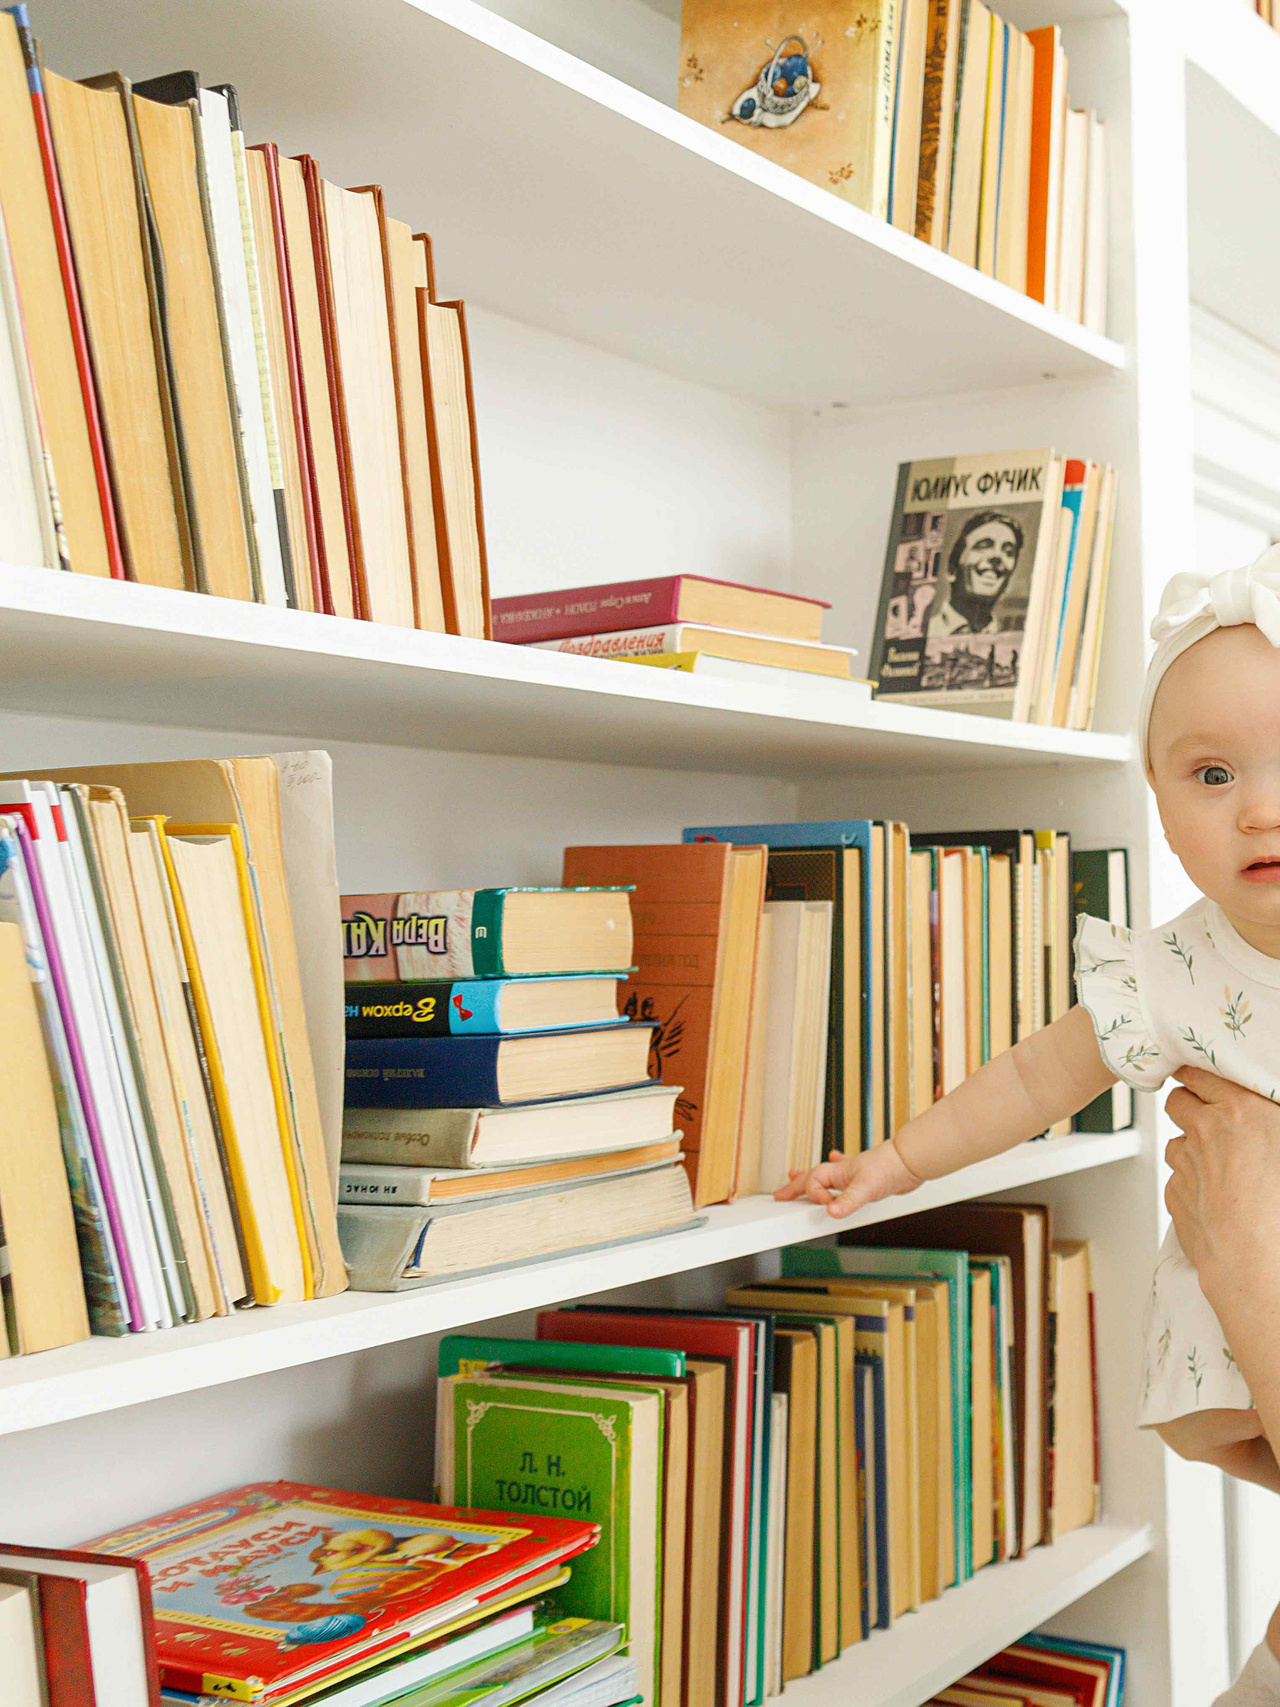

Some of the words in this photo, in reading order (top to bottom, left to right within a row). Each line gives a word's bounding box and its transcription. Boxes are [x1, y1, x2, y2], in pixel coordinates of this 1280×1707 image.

[910, 472, 972, 502] ЮЛИУС
[976, 467, 1043, 494] ФУЧИК
[362, 997, 436, 1022] Верхом
[346, 1184, 379, 1194] ЮНАС
[383, 1185, 398, 1194] ЯН
[547, 1454, 565, 1477] Н.
[495, 1479, 591, 1512] ТОЛСТОЙ
[198, 1526, 334, 1578] МАУСИ
